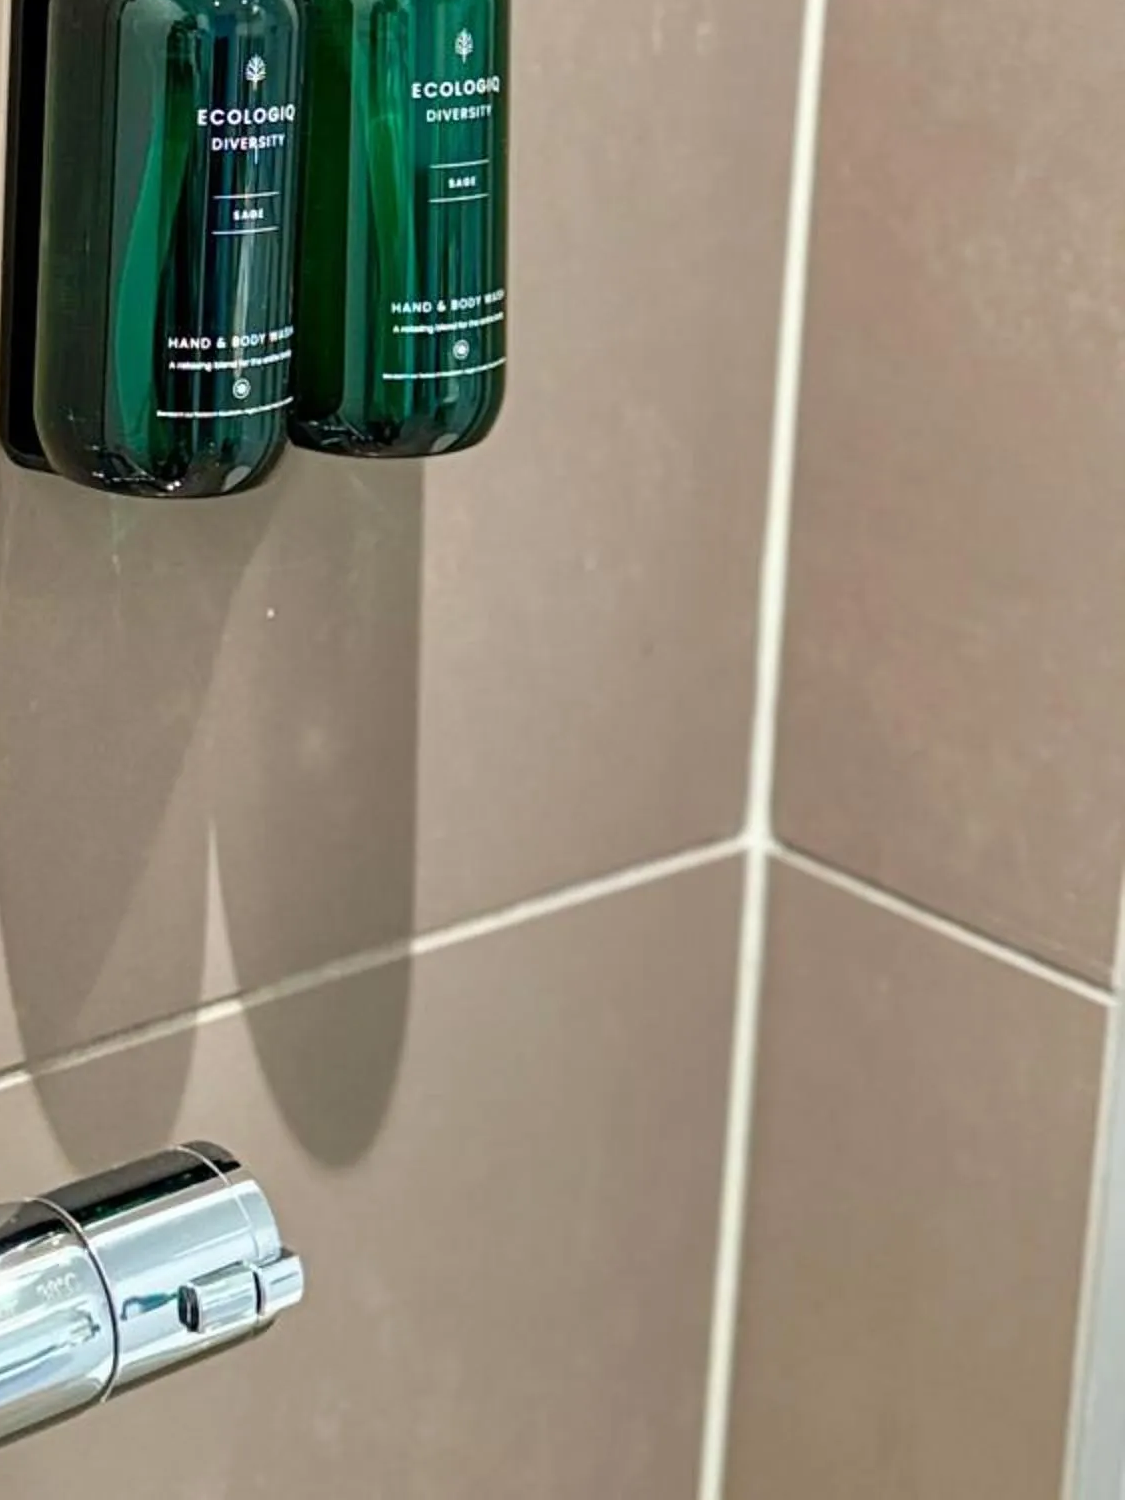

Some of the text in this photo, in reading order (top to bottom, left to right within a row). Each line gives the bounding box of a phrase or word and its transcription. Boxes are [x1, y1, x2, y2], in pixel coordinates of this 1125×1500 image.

[411, 76, 500, 99] ECOLOGIQ
[197, 104, 296, 126] ECOLOGIQ
[427, 104, 492, 122] DIVERSITY
[212, 134, 285, 150] DIVERSITY
[391, 301, 432, 313] HAND
[436, 300, 446, 312] &
[450, 295, 481, 311] BODY
[168, 336, 211, 349] HAND
[216, 337, 226, 349] &
[232, 333, 266, 348] BODY
